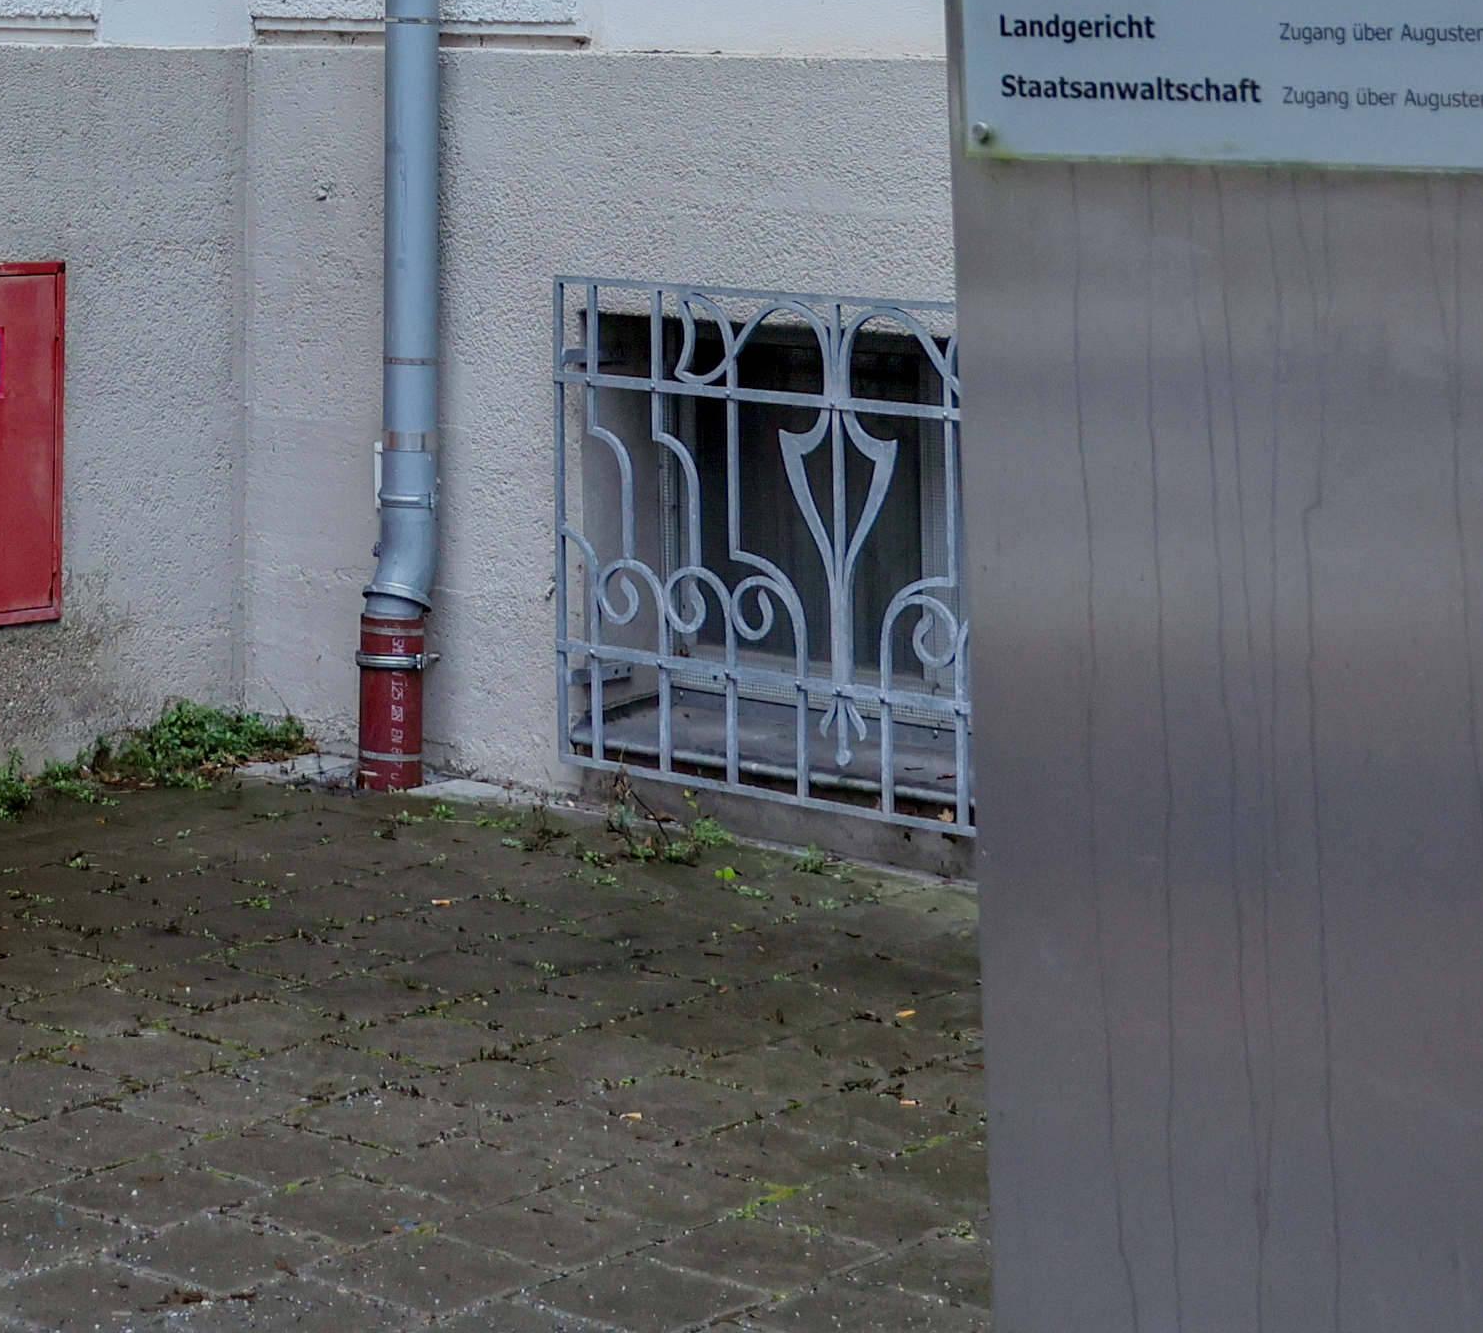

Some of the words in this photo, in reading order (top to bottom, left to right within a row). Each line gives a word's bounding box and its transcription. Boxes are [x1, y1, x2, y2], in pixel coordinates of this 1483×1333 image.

[999, 14, 1155, 44] Landgericht
[1279, 23, 1346, 45] Zugang
[1352, 23, 1393, 42] über
[1001, 74, 1263, 103] Staatsanwaltschaft
[1282, 87, 1349, 109] Zugang
[1356, 87, 1397, 107] über
